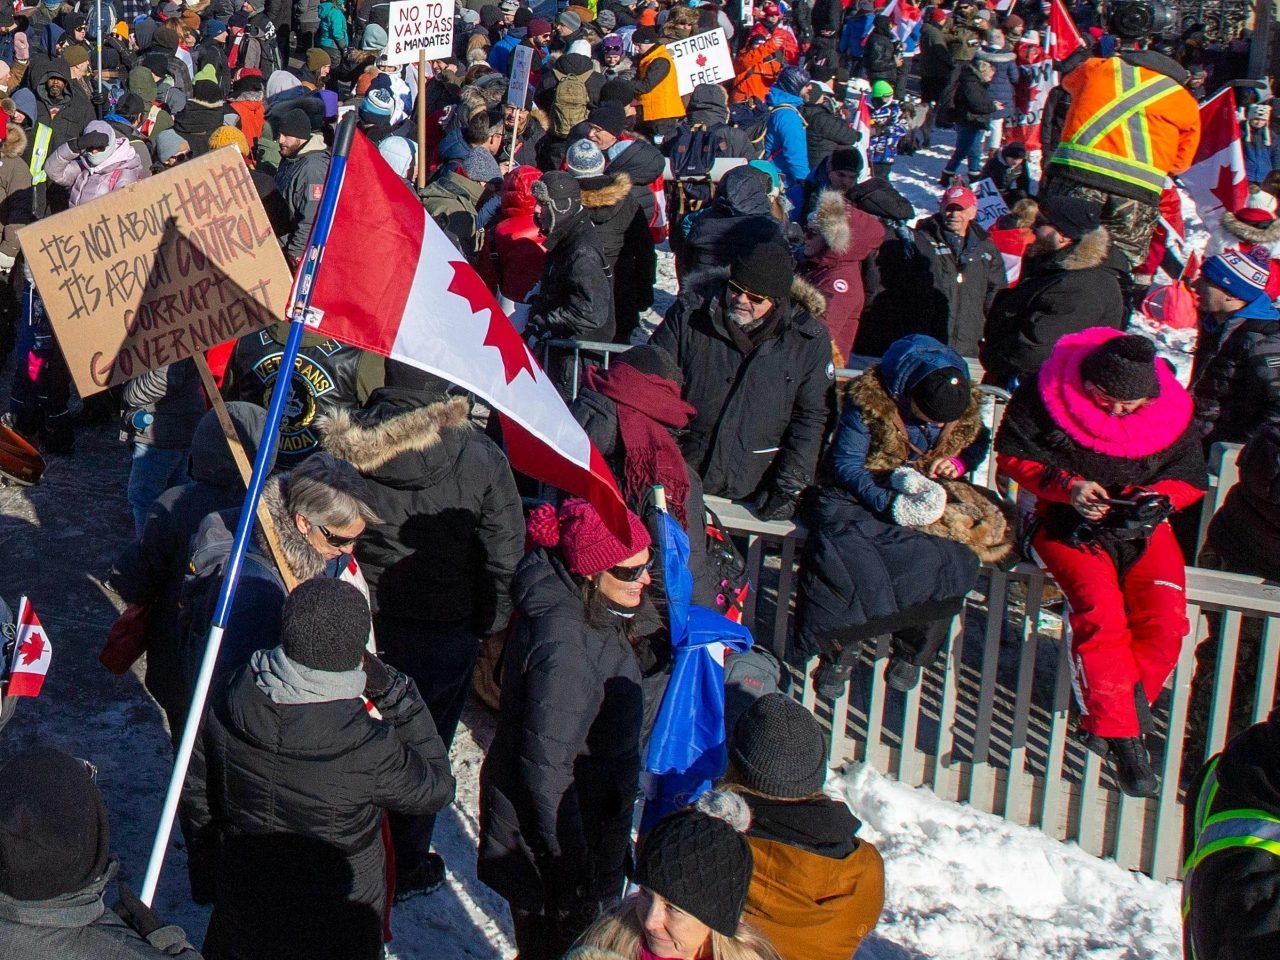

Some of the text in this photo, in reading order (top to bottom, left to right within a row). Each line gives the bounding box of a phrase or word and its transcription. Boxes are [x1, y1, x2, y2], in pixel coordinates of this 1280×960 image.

[394, 17, 452, 38] VAX PASS
[400, 3, 442, 22] NO TO
[395, 33, 450, 54] & MANDATES
[674, 32, 720, 58] STRONG
[690, 66, 721, 88] FREE
[39, 162, 257, 275] IT'S NOT ABOUT HEALTH
[59, 270, 102, 320] IT'S
[105, 242, 169, 306] ABOUT
[124, 272, 230, 338] CORRUPT
[90, 279, 273, 387] GOVERNMENT
[257, 356, 330, 392] VETRANS
